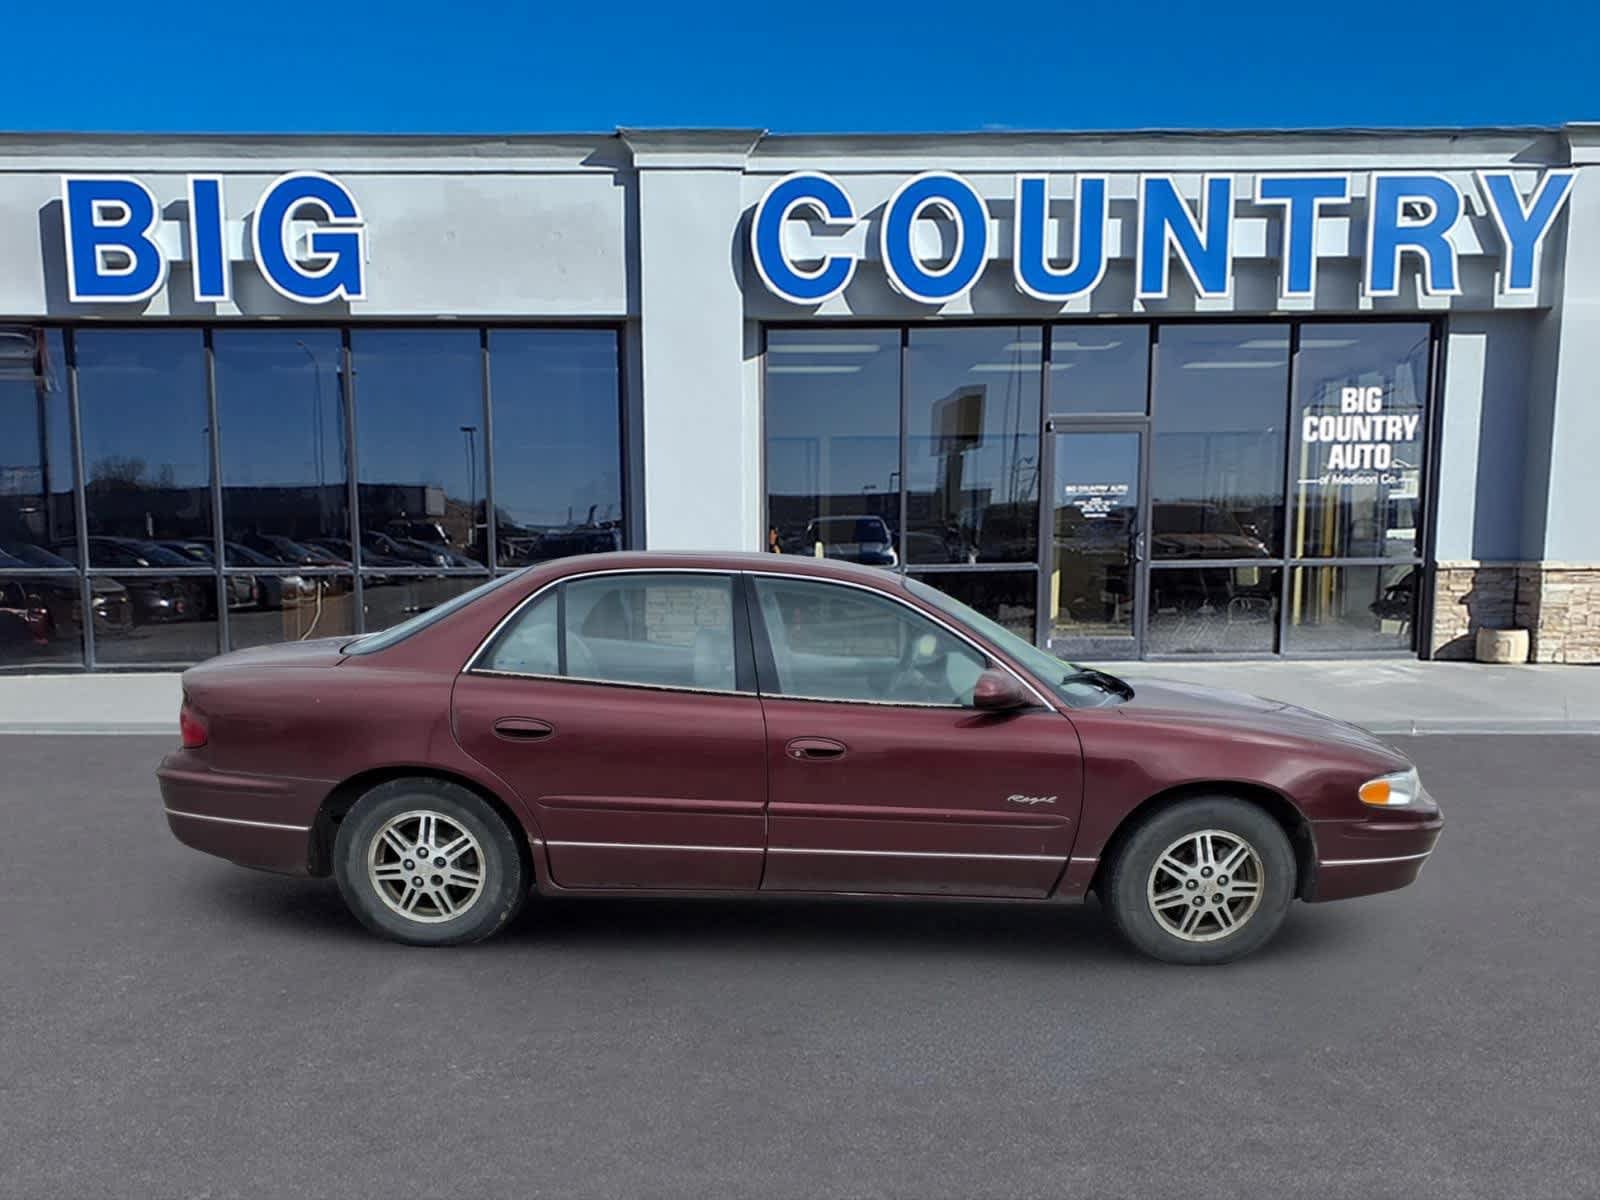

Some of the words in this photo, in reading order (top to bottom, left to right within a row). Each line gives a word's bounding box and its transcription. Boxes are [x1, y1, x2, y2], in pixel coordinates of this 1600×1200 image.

[61, 171, 367, 303] BIG
[752, 169, 1577, 304] COUNTRY
[1341, 386, 1383, 414] BIG
[1302, 414, 1420, 442] COUNTRY
[1327, 443, 1391, 470] AUTO
[1319, 473, 1330, 485] of
[1332, 472, 1379, 485] Madison
